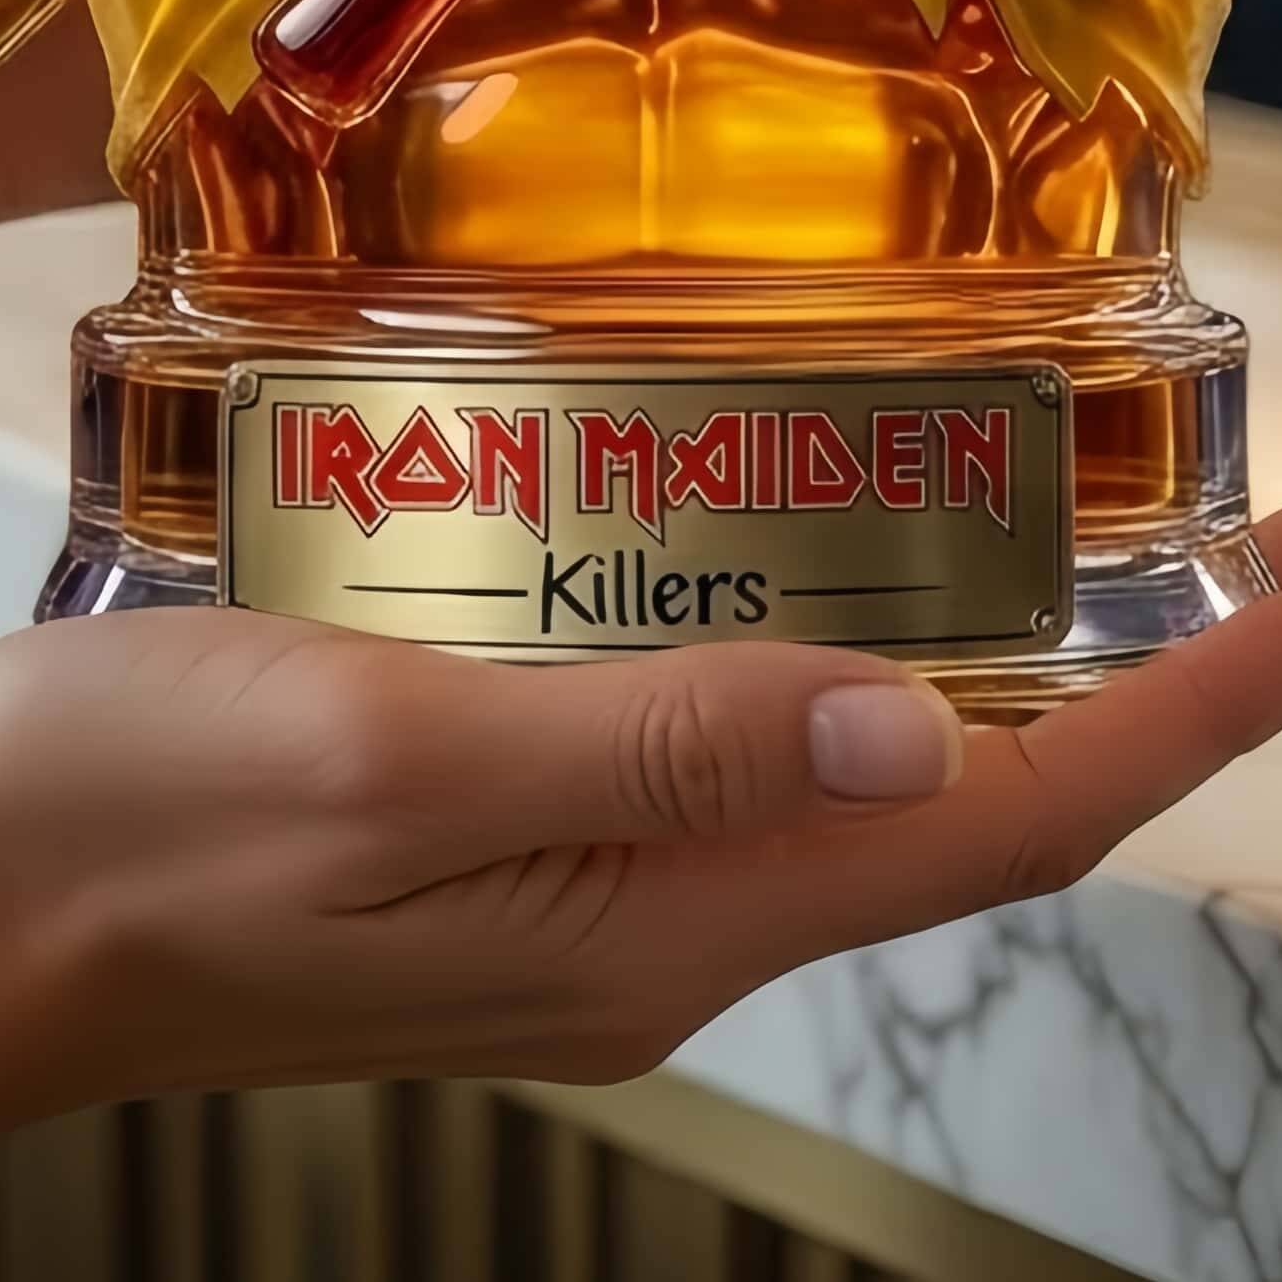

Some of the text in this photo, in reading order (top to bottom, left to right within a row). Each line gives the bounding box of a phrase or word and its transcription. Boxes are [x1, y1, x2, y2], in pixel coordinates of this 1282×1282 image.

[272, 404, 1013, 545] IRON MAIDEN
[541, 549, 769, 633] Killers
